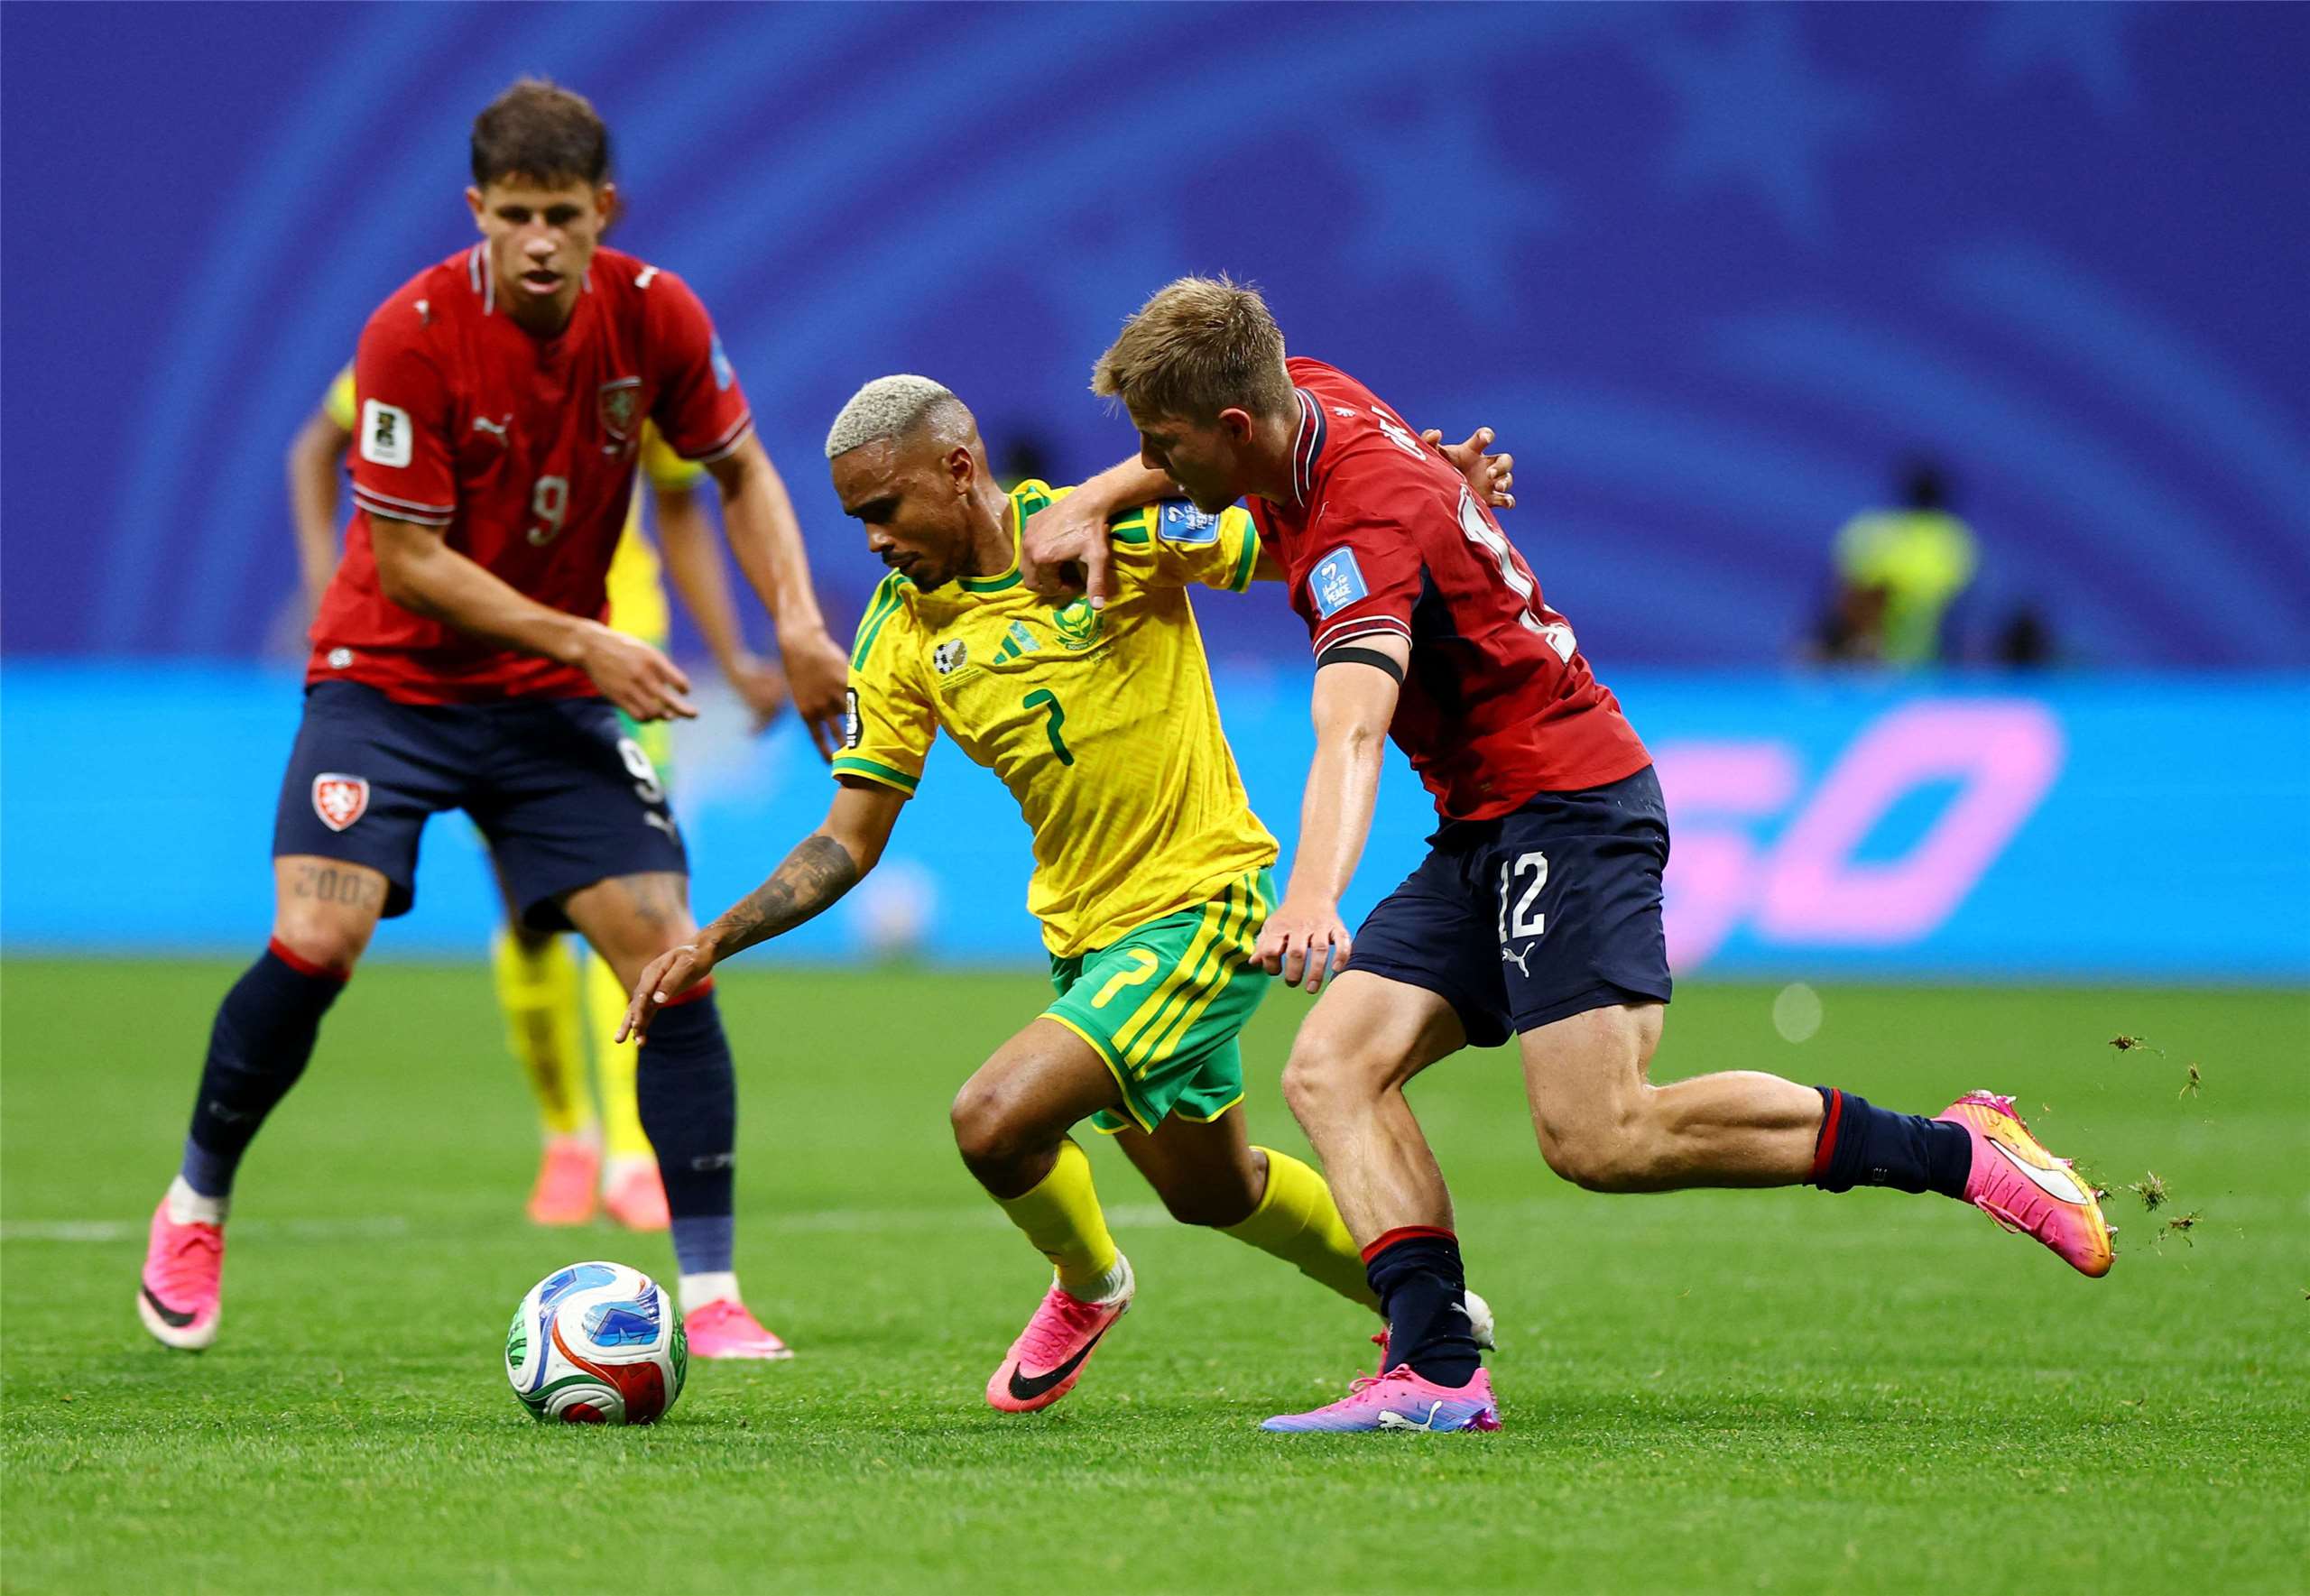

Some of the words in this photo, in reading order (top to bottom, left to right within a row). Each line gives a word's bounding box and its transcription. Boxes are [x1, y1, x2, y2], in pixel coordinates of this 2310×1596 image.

[527, 475, 568, 548] 9
[1023, 689, 1075, 766] 7
[617, 737, 666, 804] 9
[1498, 851, 1548, 944] 12
[1090, 947, 1160, 1009] 7
